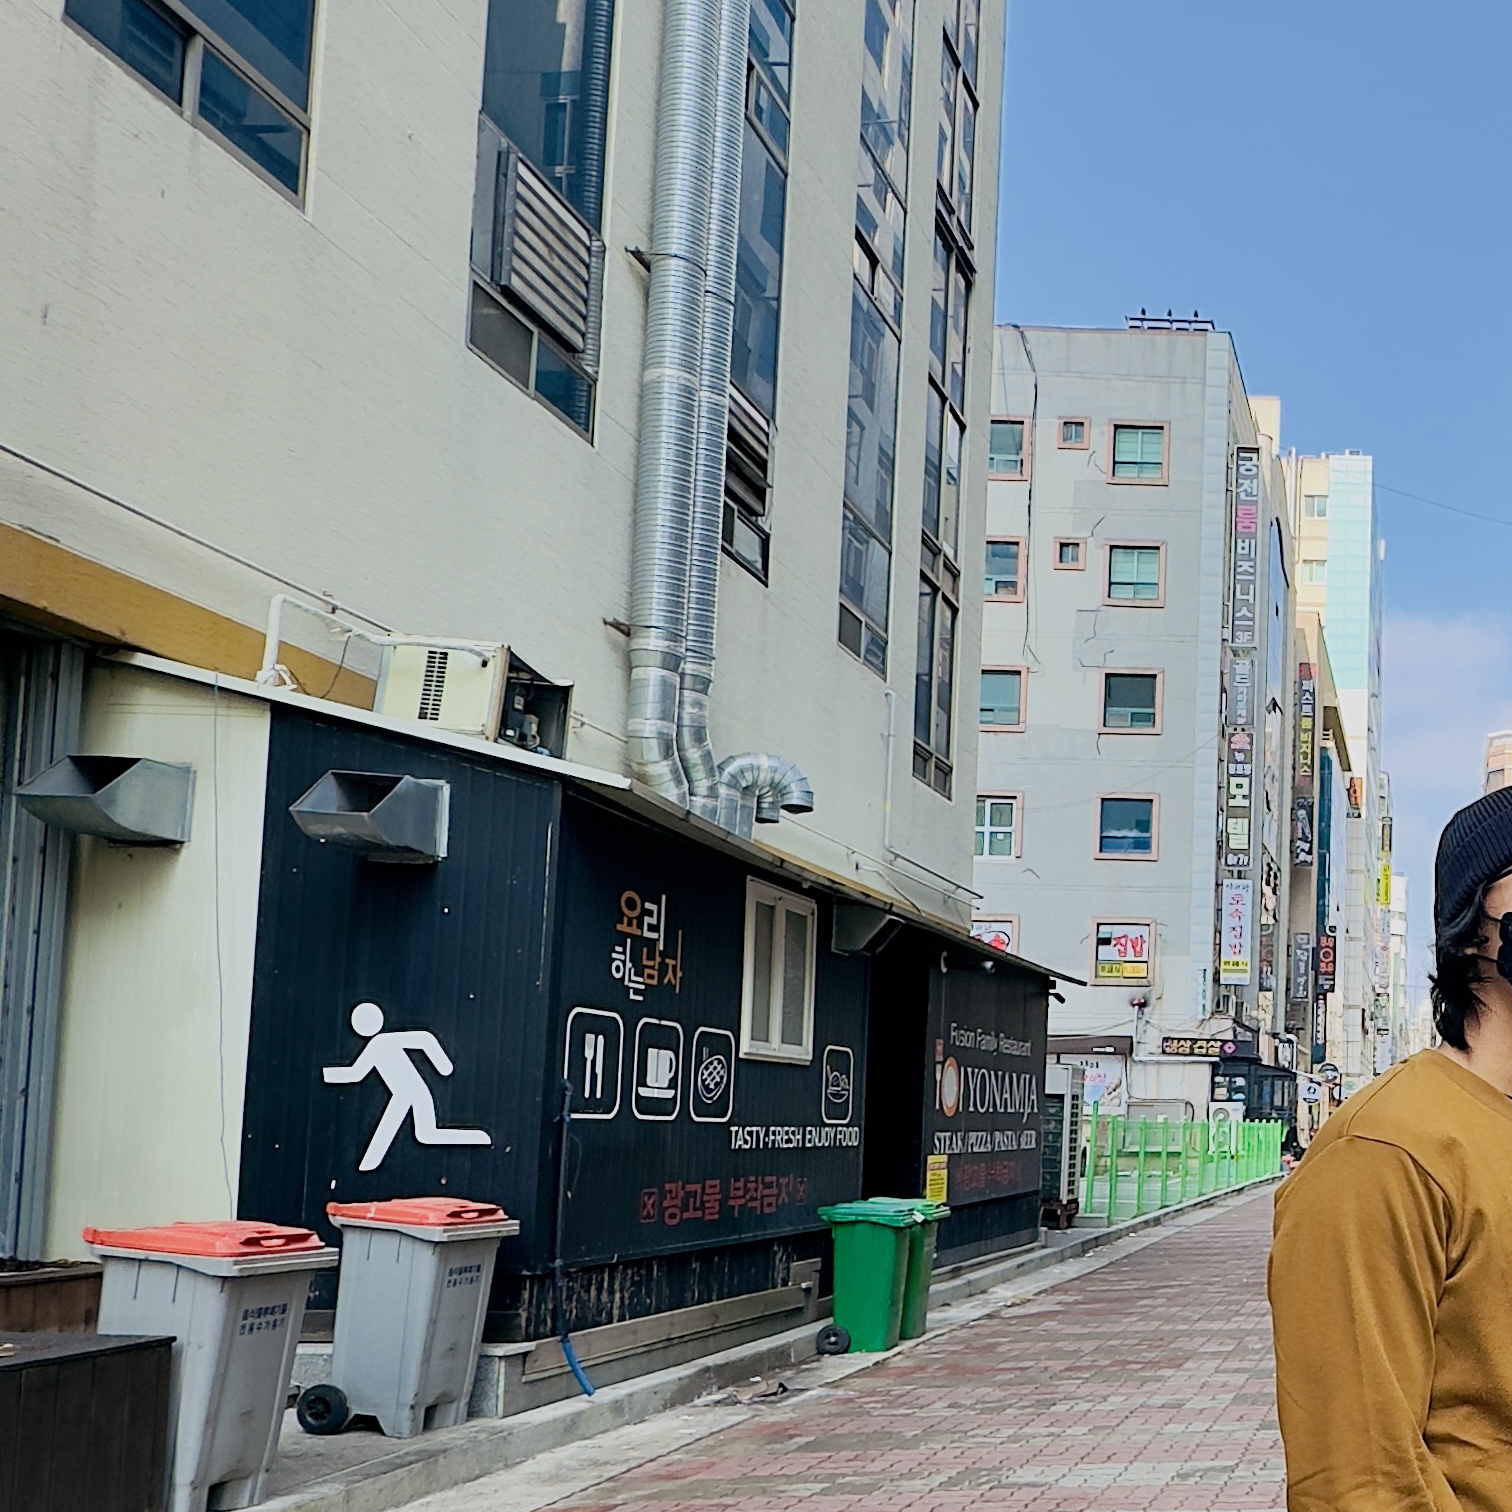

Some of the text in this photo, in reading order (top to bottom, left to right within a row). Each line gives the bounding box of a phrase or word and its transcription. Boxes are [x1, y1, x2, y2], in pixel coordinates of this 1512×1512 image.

[1235, 538, 1256, 626] 비즈니스
[1234, 631, 1253, 644] 3F
[615, 889, 667, 951] 요리
[1112, 933, 1147, 958] 집밥
[611, 929, 683, 1001] 하는 남자
[949, 1022, 976, 1049] Fusion
[967, 1065, 1039, 1124] YONAMJA
[804, 1126, 836, 1148] ENJOY
[836, 1126, 860, 1147] FOOD
[661, 1173, 795, 1227] 광고물 부착금지
